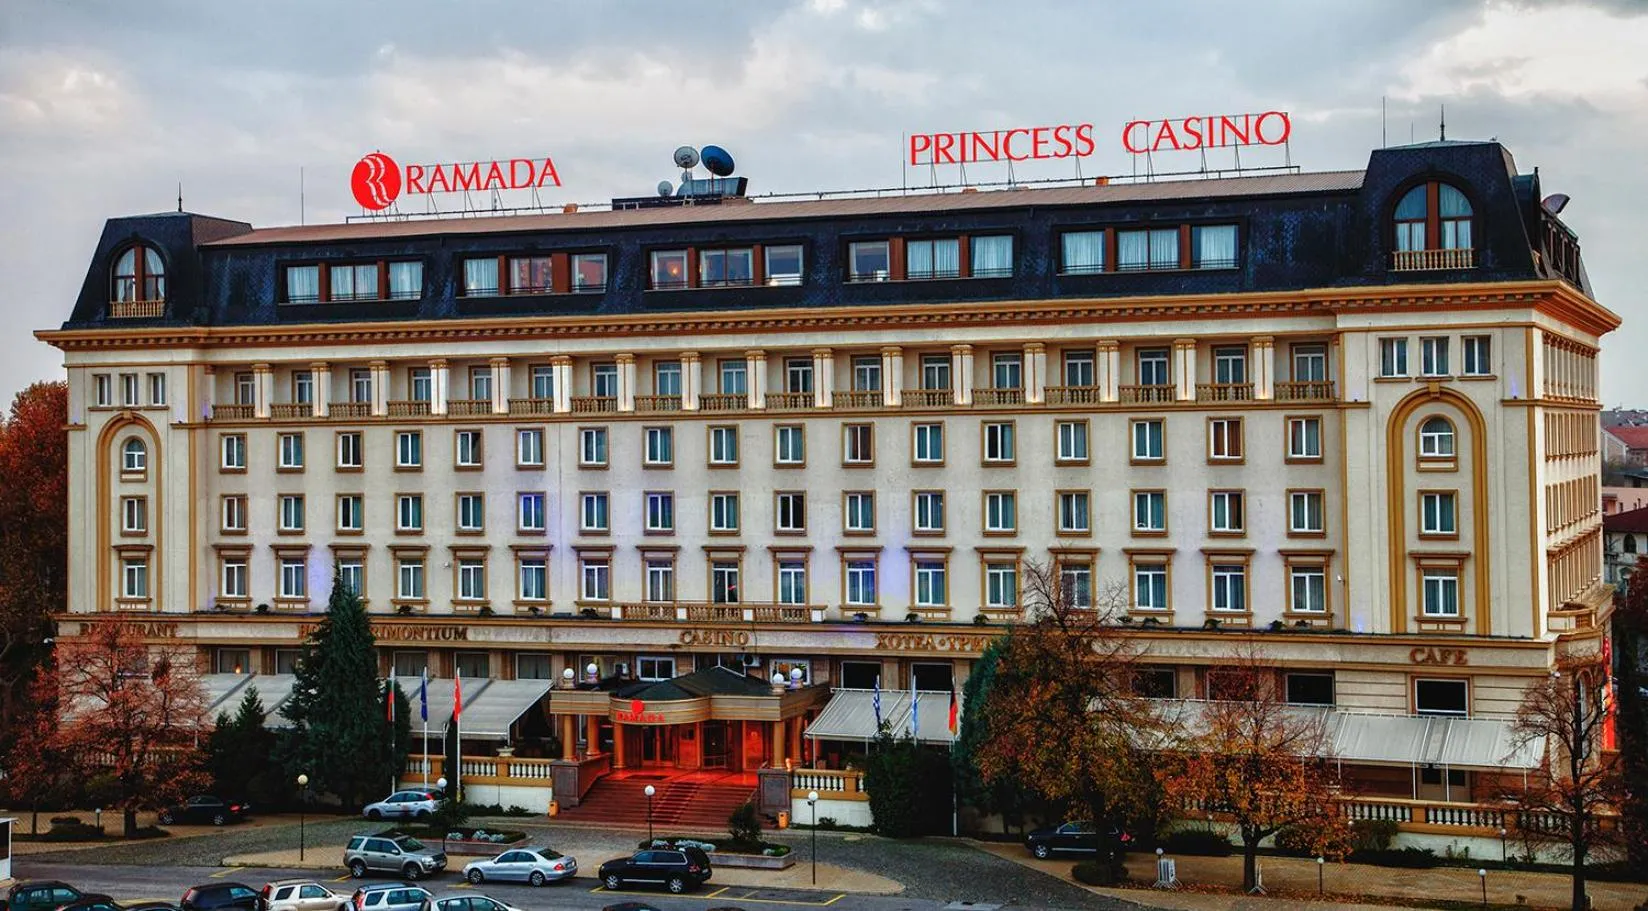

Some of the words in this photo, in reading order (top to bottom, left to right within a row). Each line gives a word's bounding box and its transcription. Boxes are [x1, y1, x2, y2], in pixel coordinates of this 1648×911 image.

[910, 124, 1095, 166] PRINCESS
[1122, 111, 1292, 154] CASINO
[406, 157, 562, 194] RAMADA
[79, 622, 178, 638] REAURANT
[369, 624, 468, 641] RIMONTIUM
[679, 630, 749, 646] CASINO
[1409, 646, 1469, 665] CAFE
